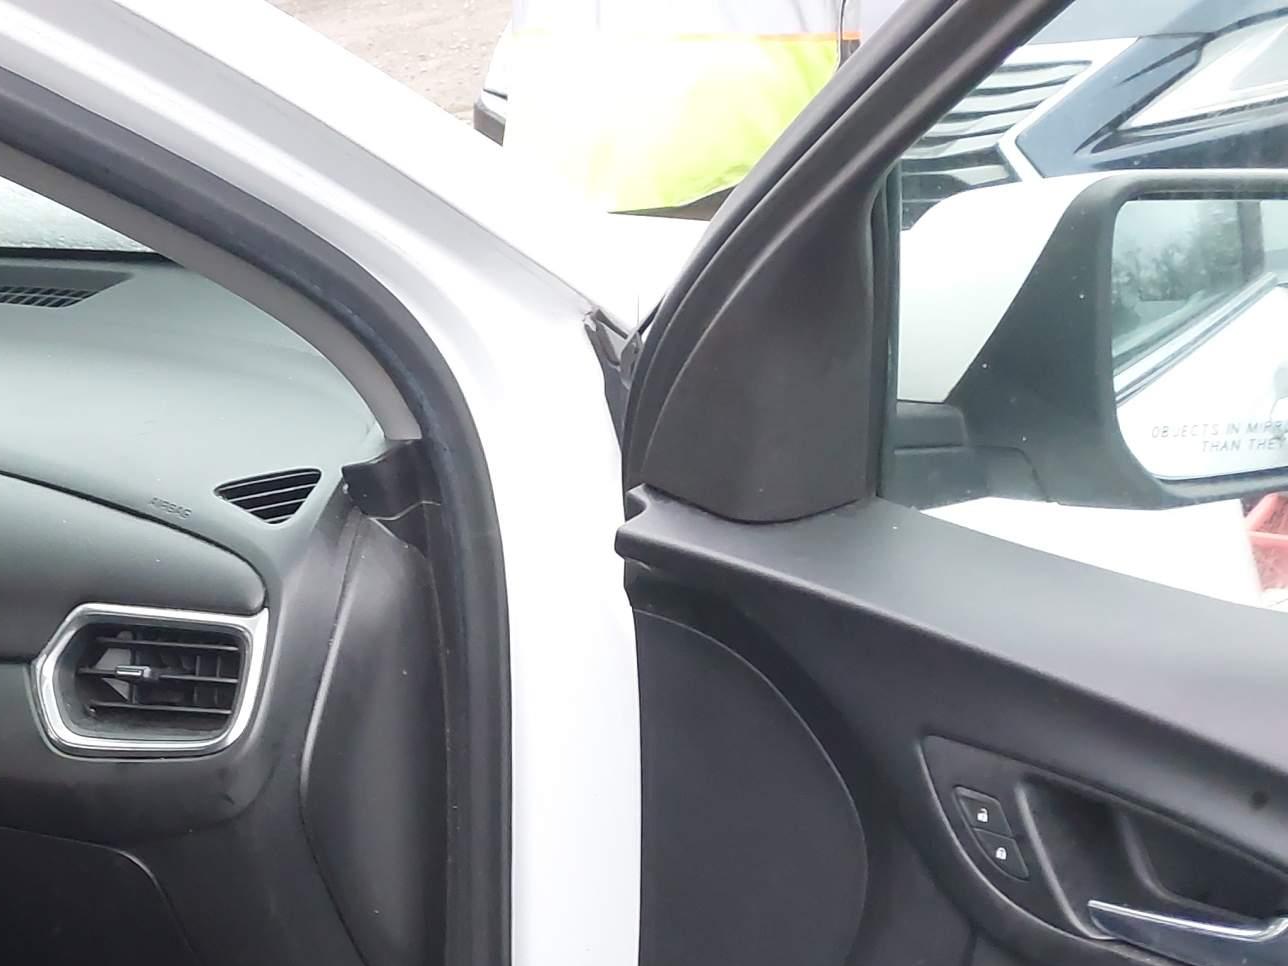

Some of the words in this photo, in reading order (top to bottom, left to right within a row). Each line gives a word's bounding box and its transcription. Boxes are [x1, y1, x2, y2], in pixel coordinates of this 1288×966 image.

[1151, 423, 1220, 439] OBJECTS
[1226, 421, 1240, 435] IN
[1247, 420, 1288, 434] MIRR
[1201, 439, 1241, 453] THAN
